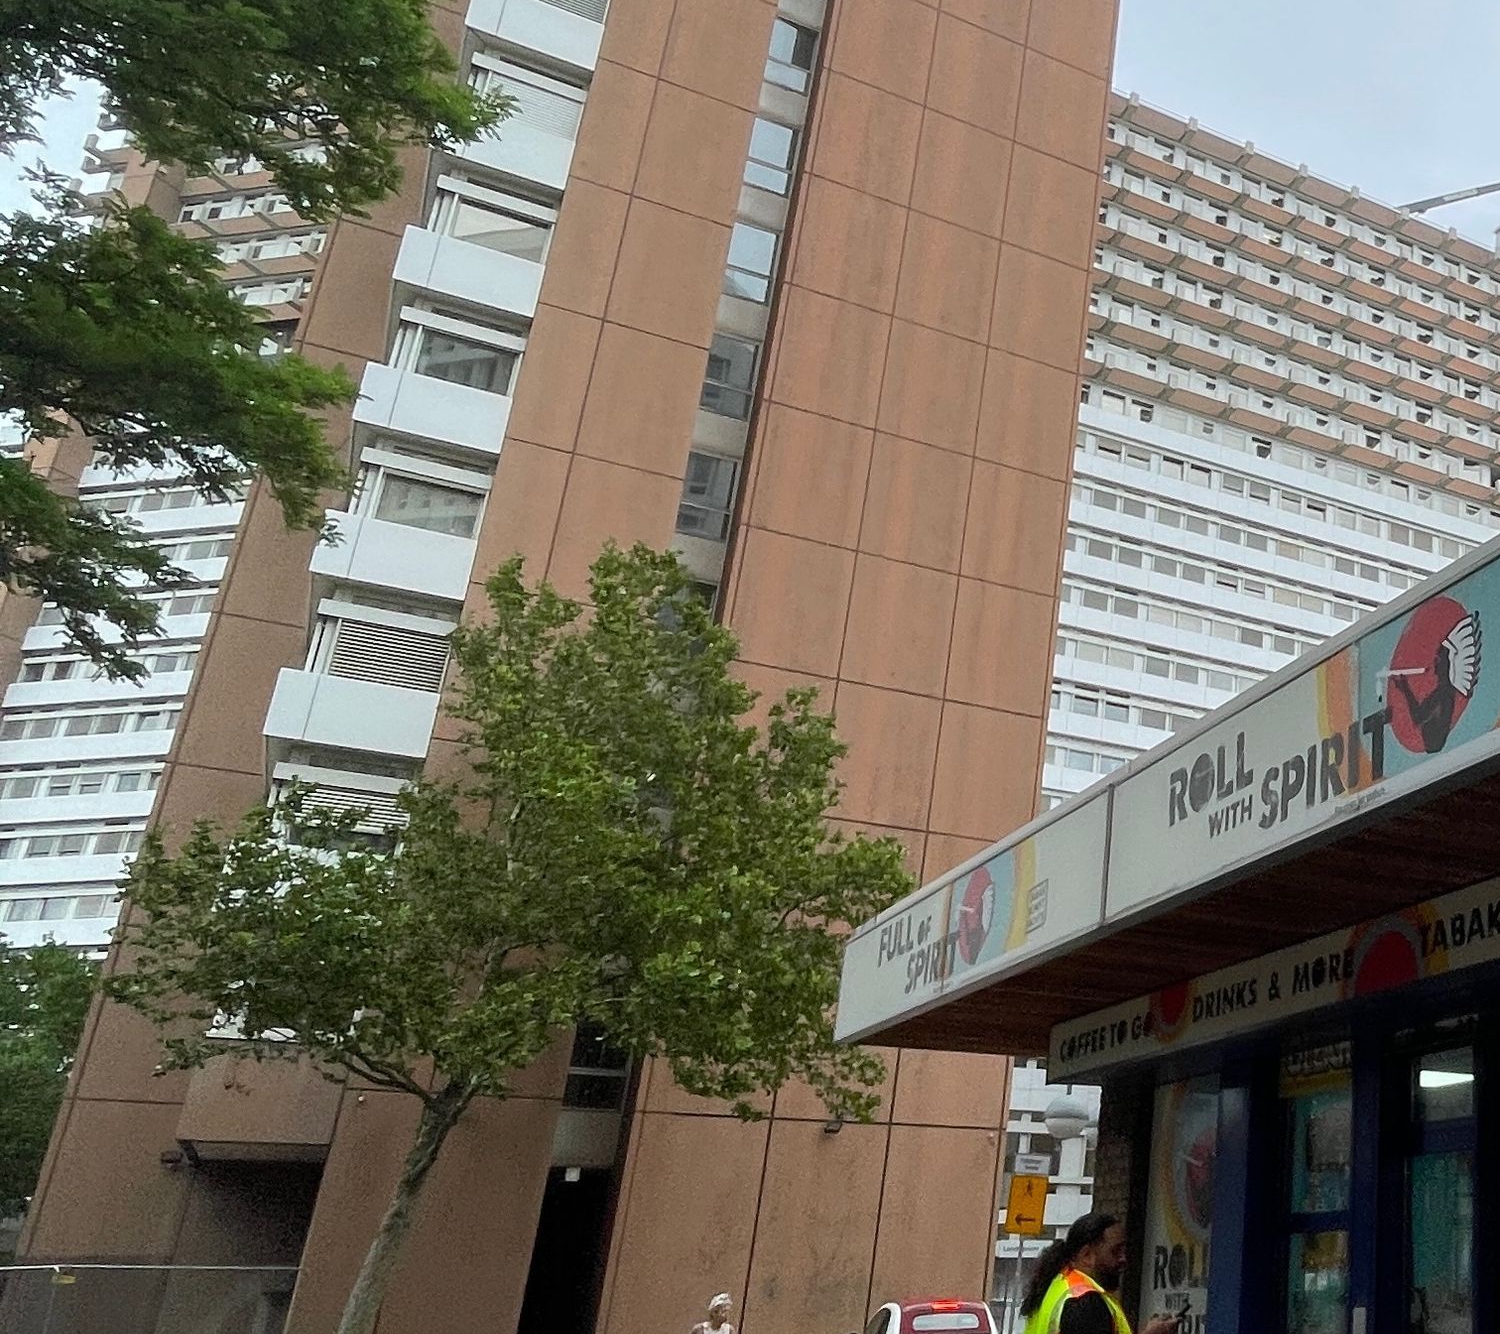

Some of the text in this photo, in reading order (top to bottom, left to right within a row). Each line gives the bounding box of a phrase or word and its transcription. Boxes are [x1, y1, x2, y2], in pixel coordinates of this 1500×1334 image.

[1168, 731, 1253, 828] ROLL
[1258, 705, 1393, 830] SPIRIT
[1208, 794, 1253, 839] WITH
[877, 913, 914, 968] FULL
[917, 914, 933, 945] OF
[1192, 948, 1356, 1023] DRINKS & MORE
[1060, 1010, 1155, 1064] COFFEE TO GO
